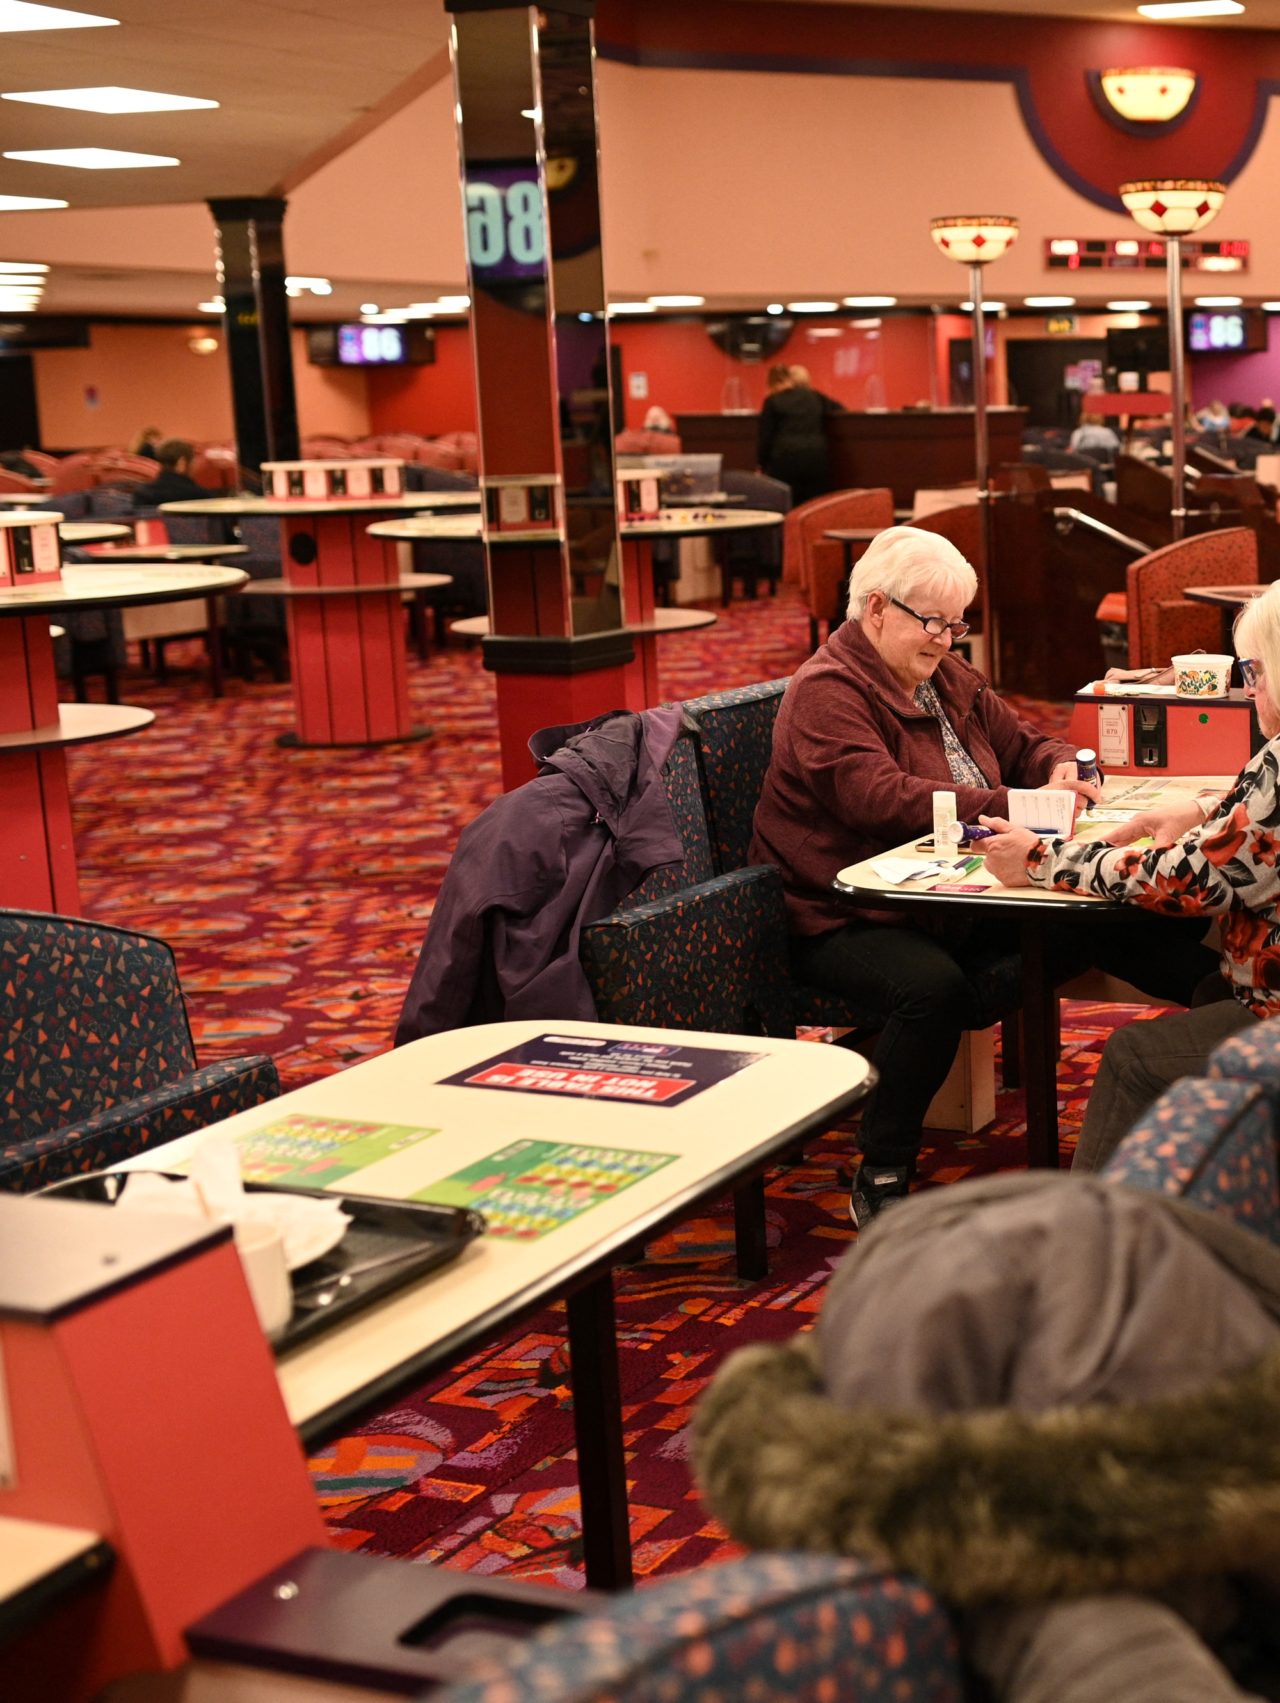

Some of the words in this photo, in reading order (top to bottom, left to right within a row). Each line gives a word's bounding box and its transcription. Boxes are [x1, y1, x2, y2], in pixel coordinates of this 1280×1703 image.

[484, 1074, 517, 1084] IS
[514, 1068, 568, 1081] USE
[569, 1073, 602, 1083] IN
[521, 1077, 594, 1094] TABLE
[603, 1076, 658, 1088] NOT
[598, 1083, 657, 1098] THIS
